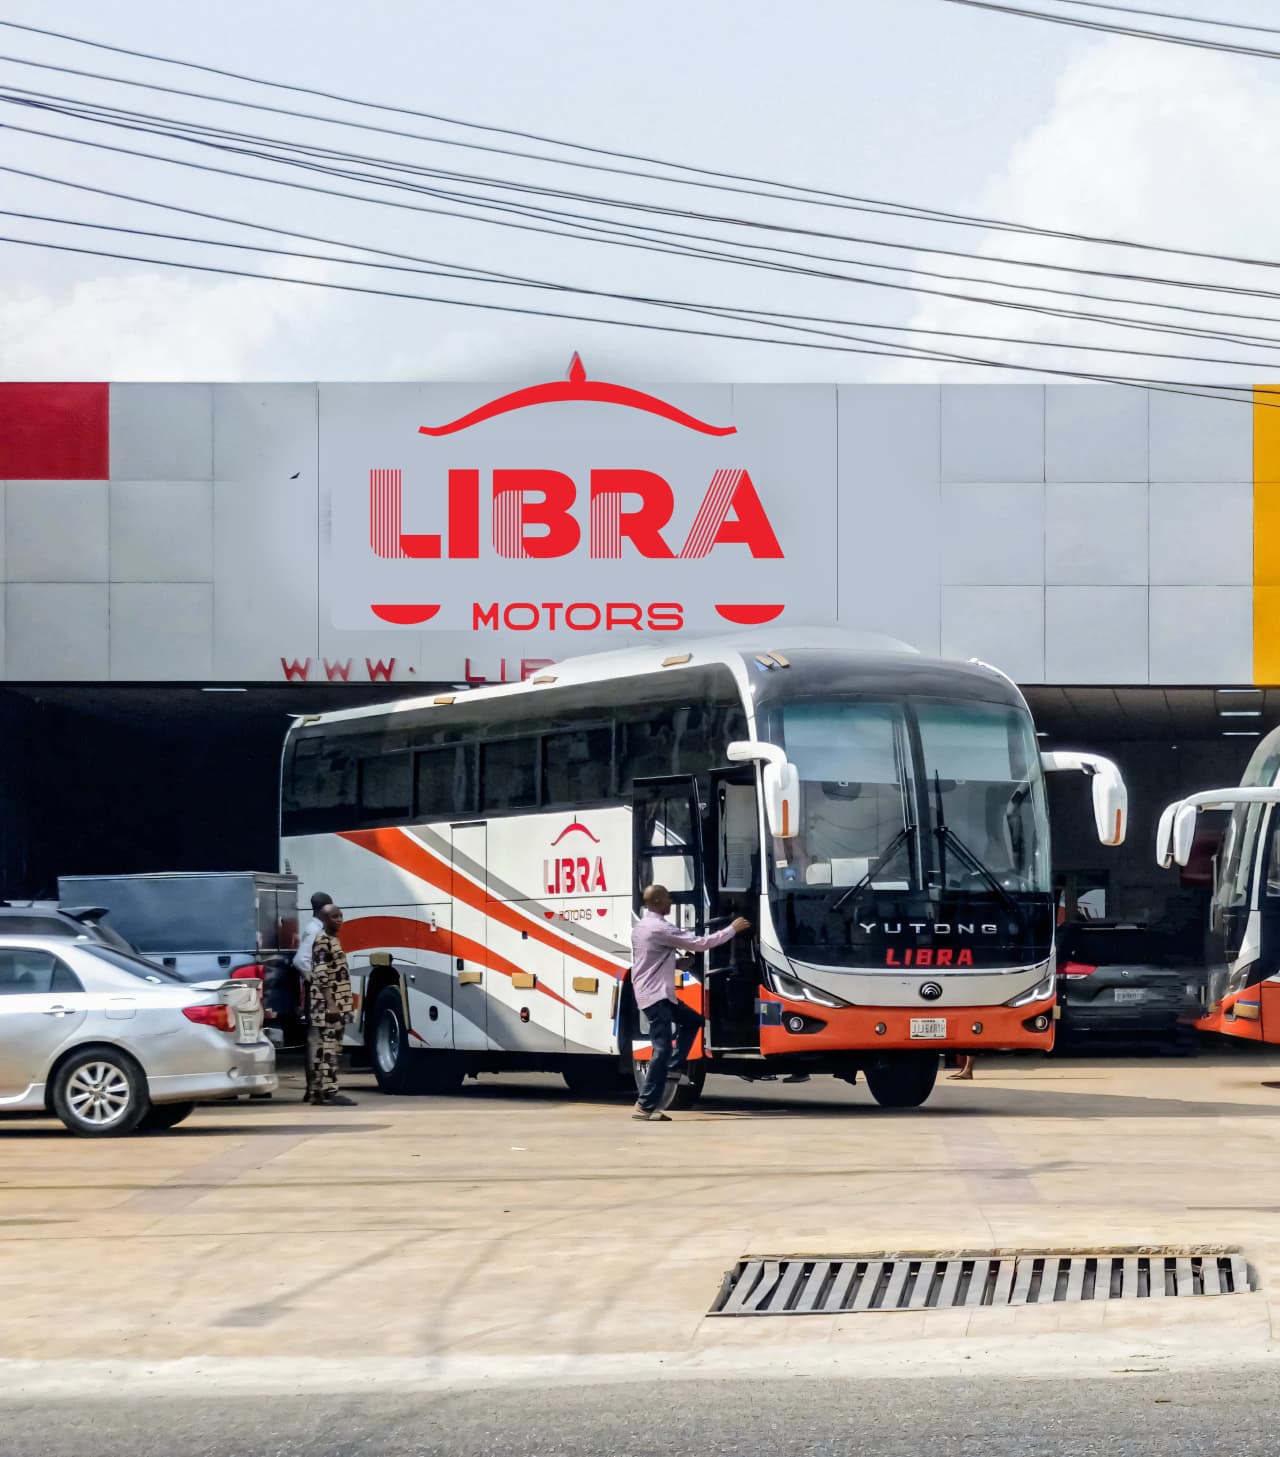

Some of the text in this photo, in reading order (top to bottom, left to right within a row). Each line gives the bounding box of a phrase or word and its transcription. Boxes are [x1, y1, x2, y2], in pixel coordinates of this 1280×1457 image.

[370, 468, 785, 559] LIBRA
[473, 602, 684, 631] MOTORS
[543, 856, 607, 894] LIBRA
[859, 923, 998, 934] YUTONG
[885, 948, 974, 966] LIBRA
